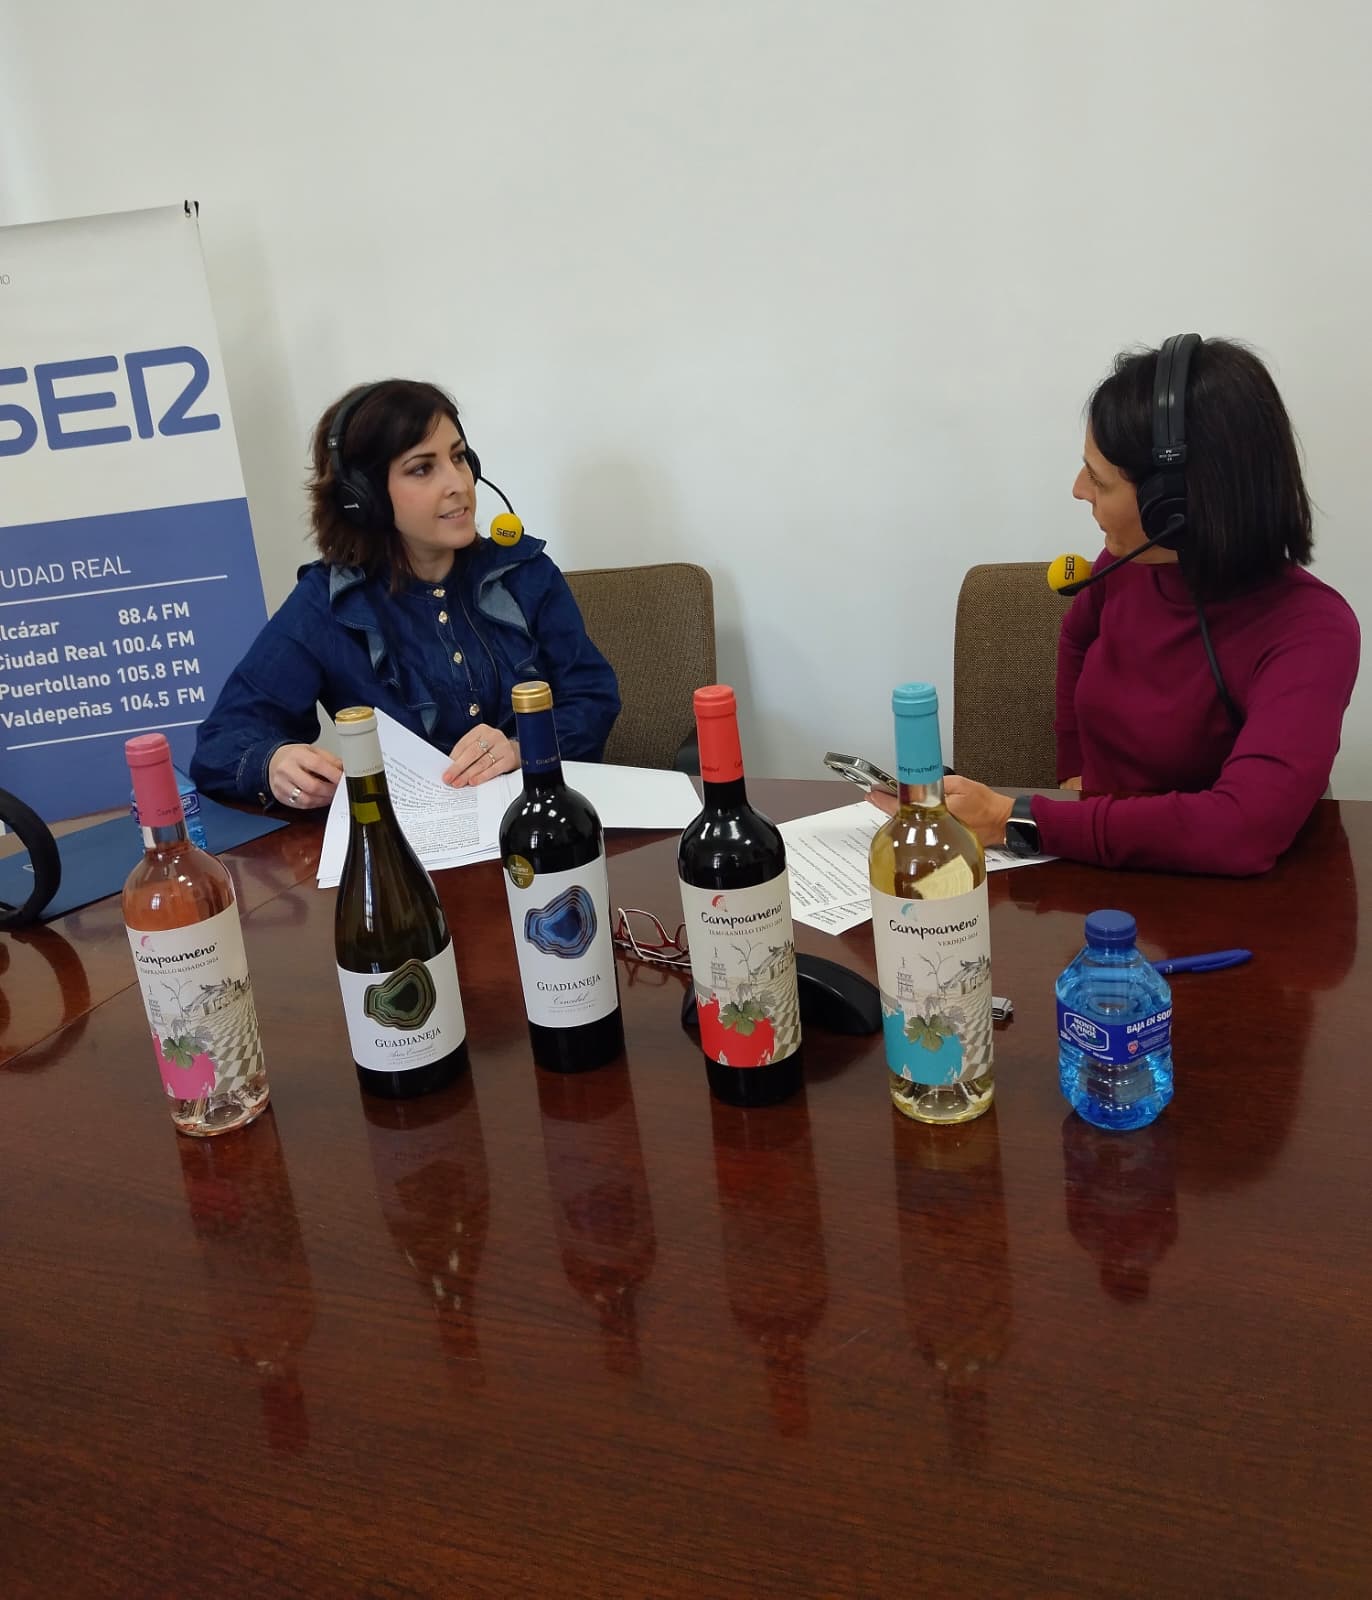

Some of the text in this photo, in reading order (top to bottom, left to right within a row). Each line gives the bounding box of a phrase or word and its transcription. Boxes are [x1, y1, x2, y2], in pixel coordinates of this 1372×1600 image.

[495, 527, 516, 538] SER
[71, 556, 131, 580] REAL
[1065, 556, 1075, 580] SER
[0, 601, 190, 641] lcázar 88.4 FM
[64, 641, 107, 662] Real
[112, 634, 162, 656] 100.4
[166, 630, 195, 649] FM
[0, 658, 201, 700] Puertollano 105.8 FM
[0, 686, 206, 729] Valdepeñas 104.5 FM
[701, 902, 783, 929] Campoameno
[889, 918, 977, 940] Campoameno
[536, 973, 601, 992] GUADIANEJA
[1126, 1021, 1145, 1035] BAJA
[1146, 1015, 1156, 1027] EN
[374, 1027, 442, 1048] GUADIANEJA
